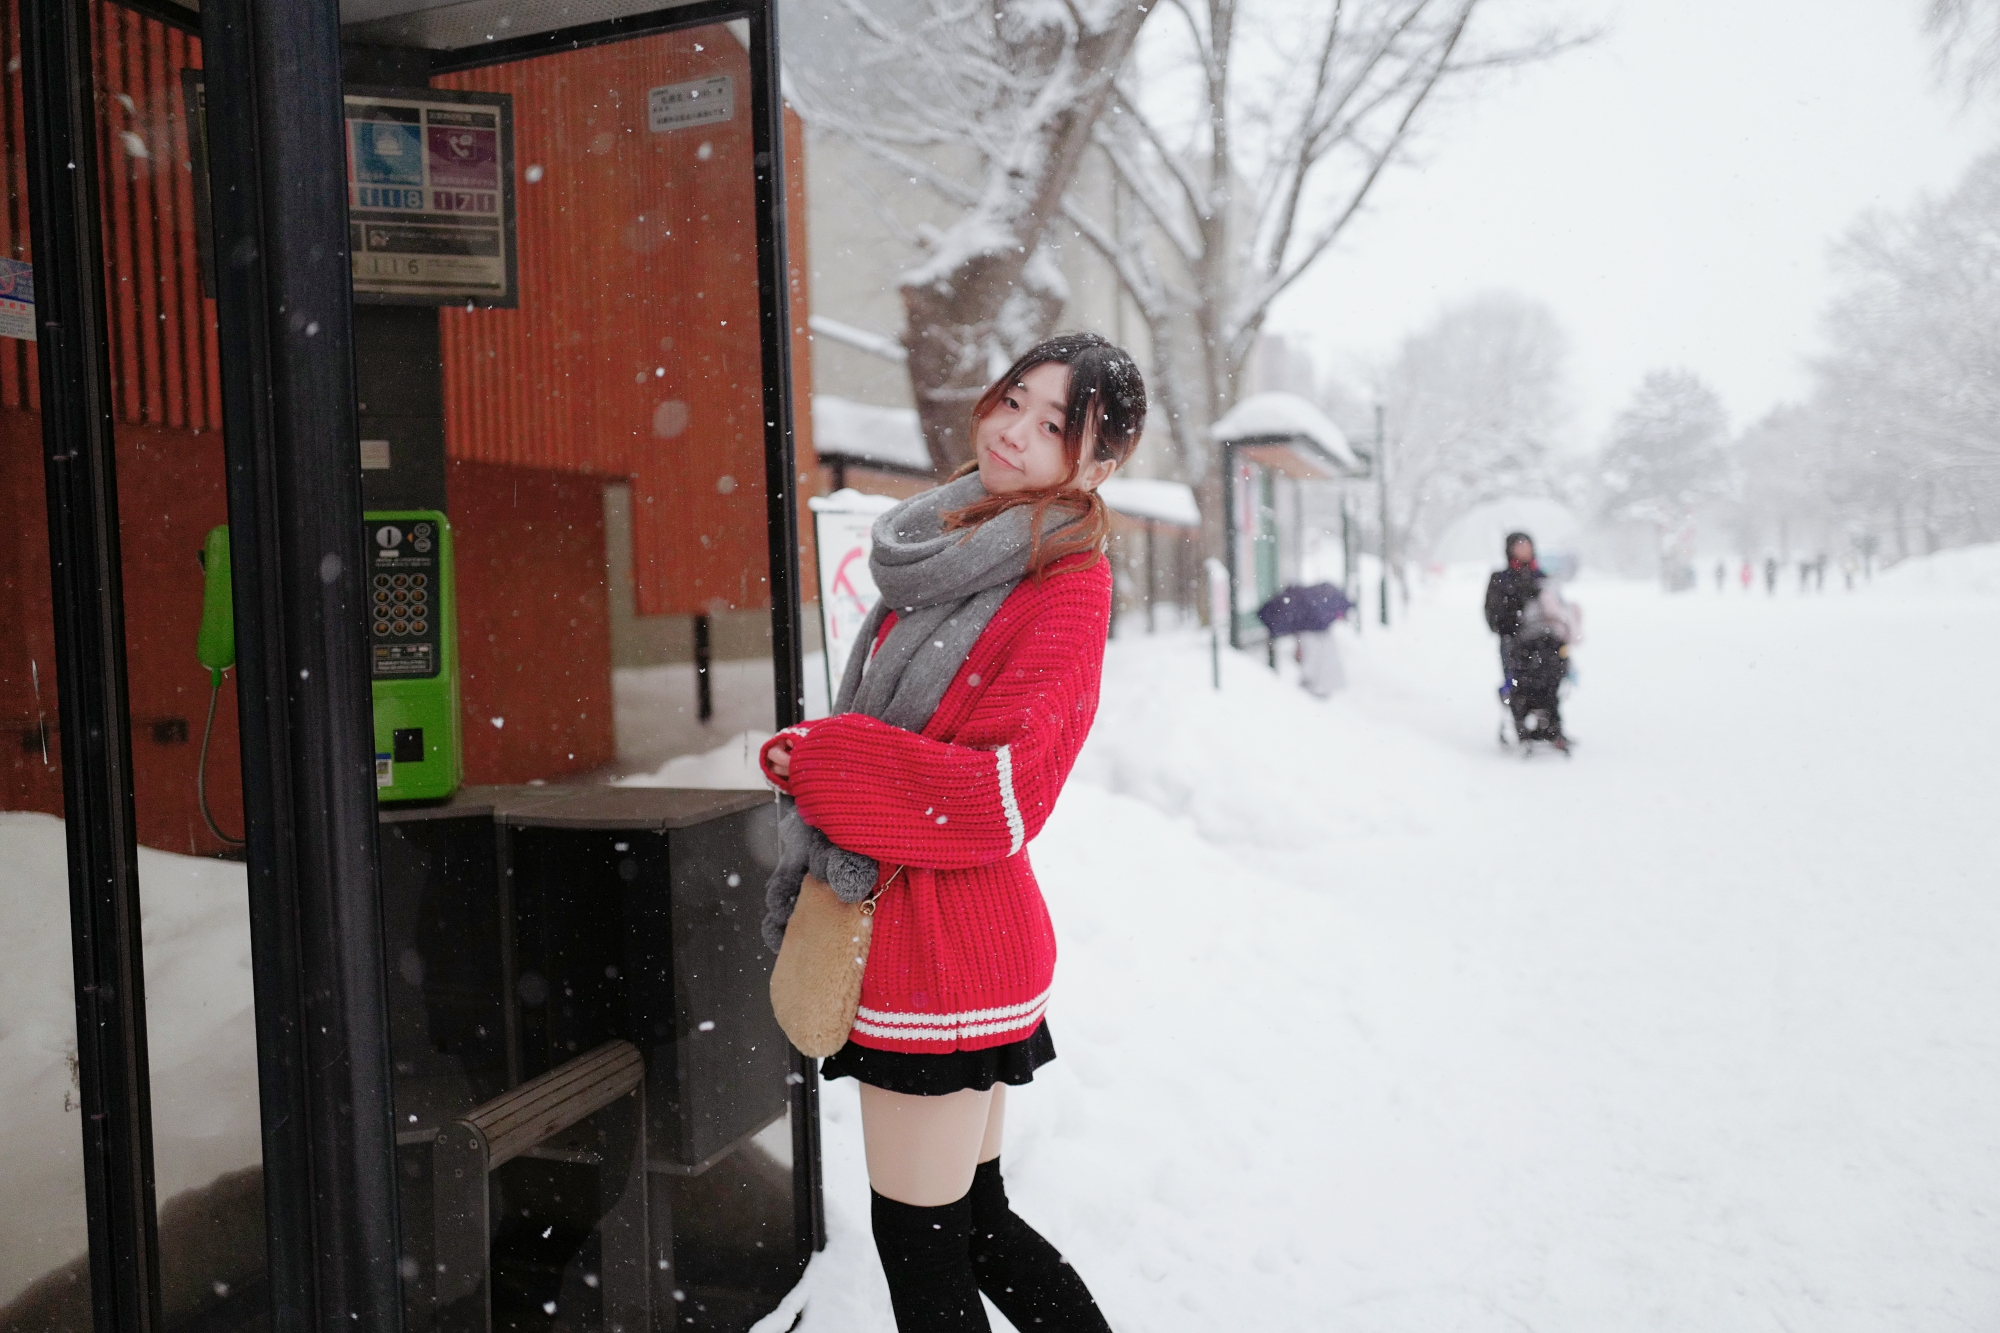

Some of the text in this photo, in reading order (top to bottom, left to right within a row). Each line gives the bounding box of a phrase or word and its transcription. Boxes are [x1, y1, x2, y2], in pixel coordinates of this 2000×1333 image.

[365, 187, 421, 208] 118
[440, 192, 490, 211] 171
[373, 258, 419, 275] 116
